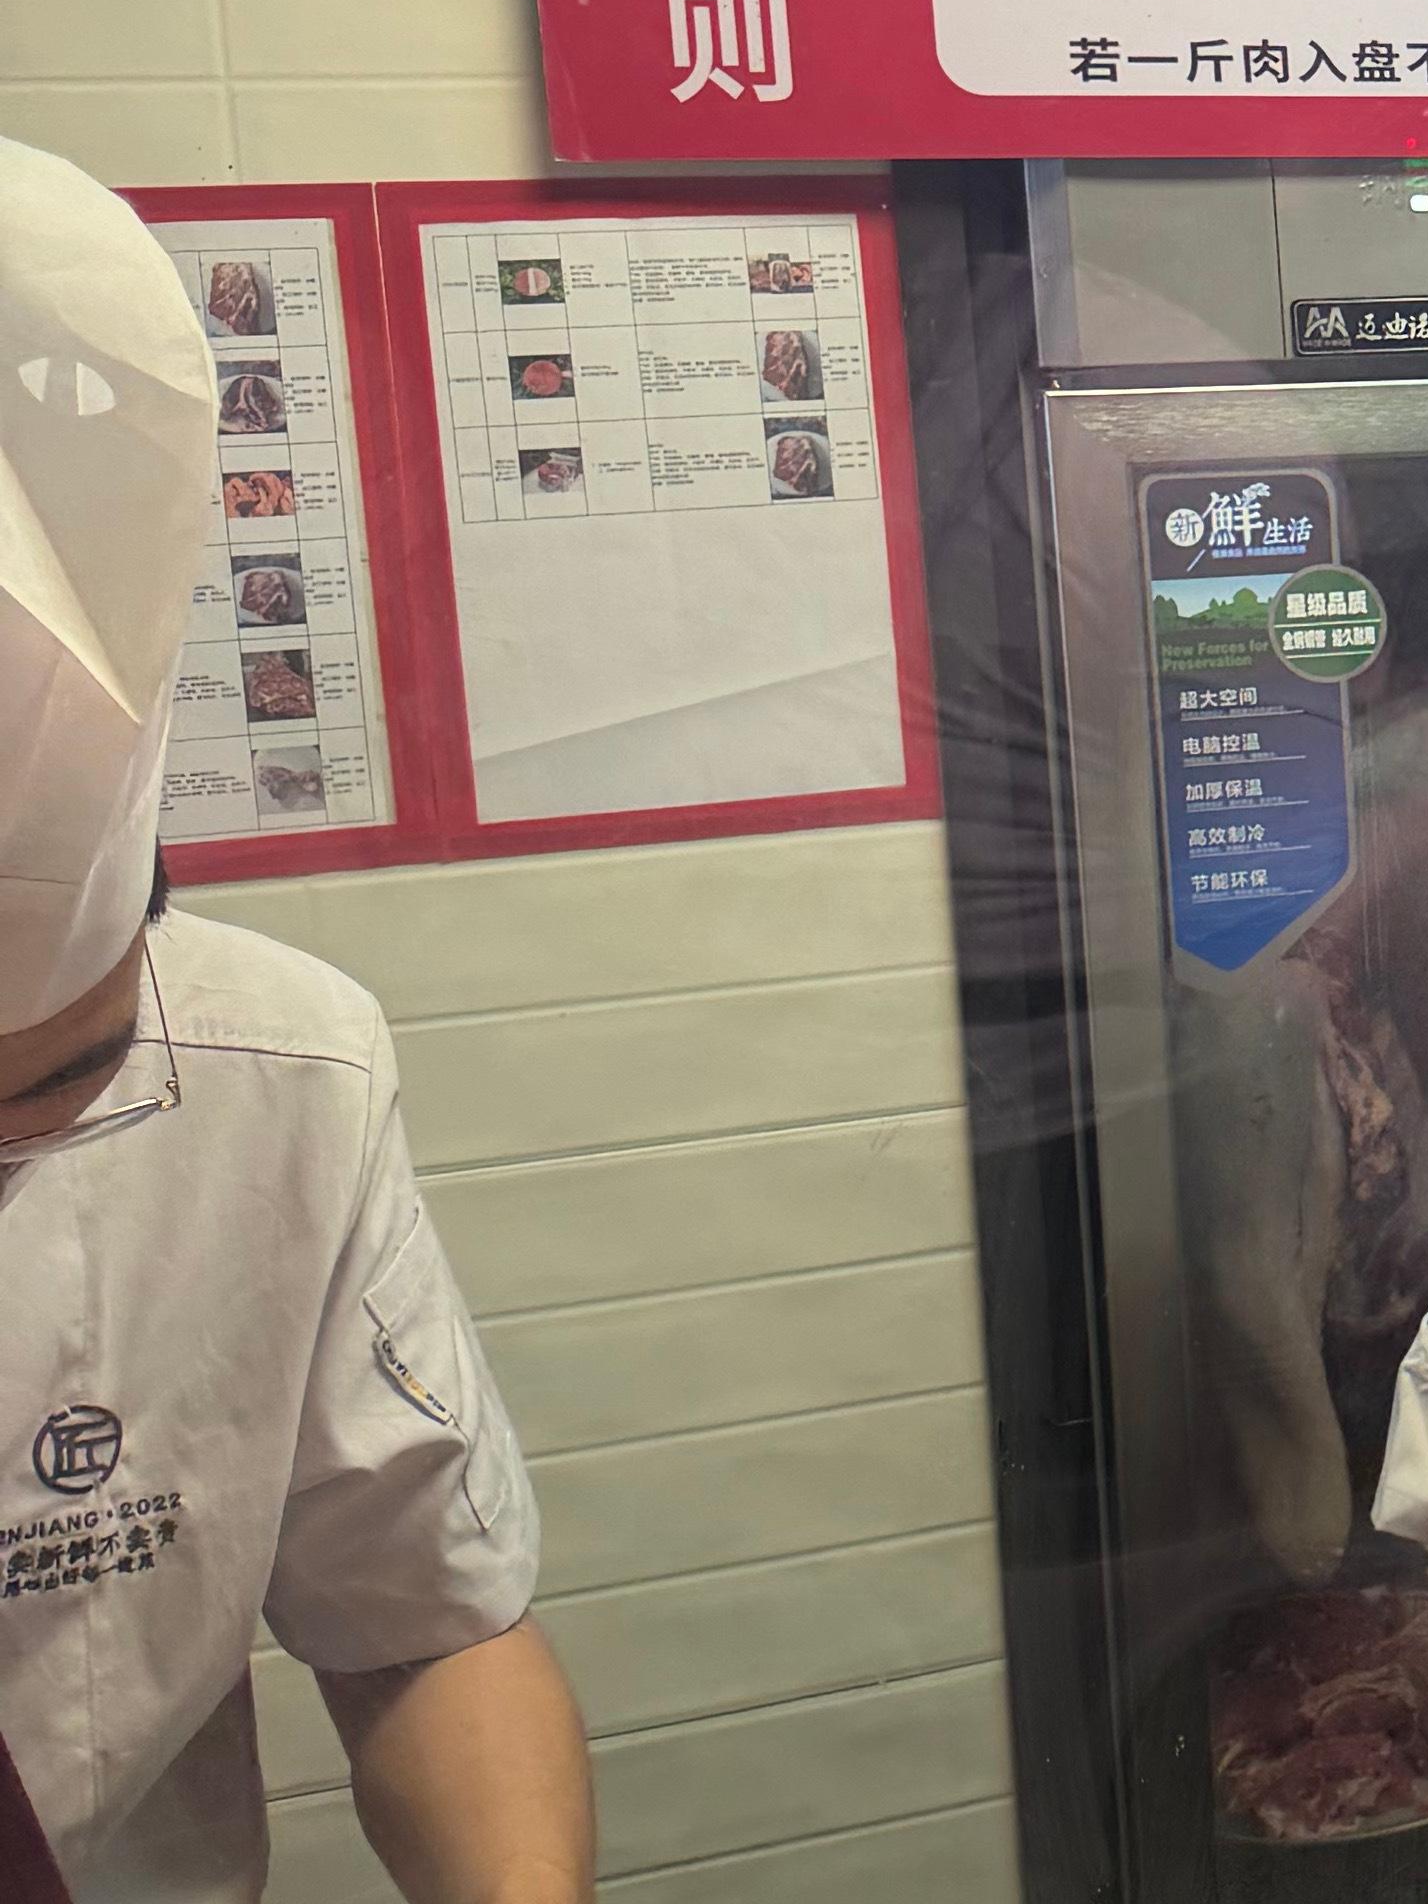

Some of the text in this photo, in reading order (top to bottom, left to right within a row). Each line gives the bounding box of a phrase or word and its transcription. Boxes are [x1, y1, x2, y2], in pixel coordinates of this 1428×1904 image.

[1179, 687, 1258, 710] 超大空间
[1185, 778, 1263, 802] 加厚保温
[1188, 823, 1266, 847] 高效制冷
[1191, 868, 1269, 893] 节能环保
[120, 1492, 182, 1520] 2022
